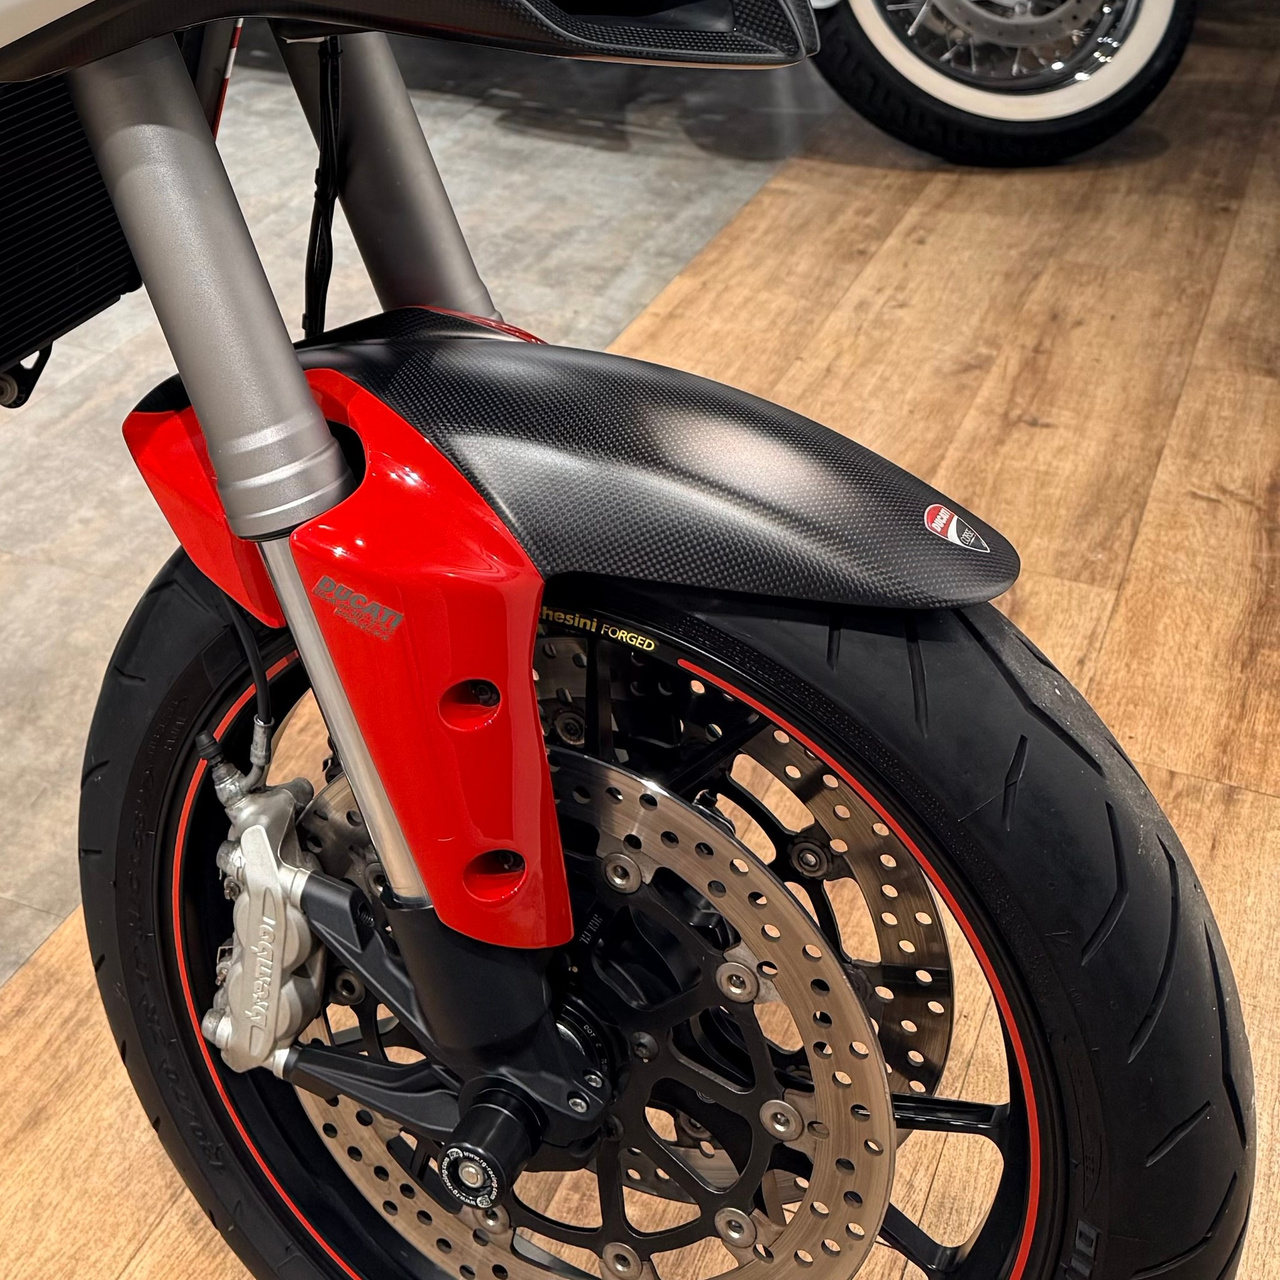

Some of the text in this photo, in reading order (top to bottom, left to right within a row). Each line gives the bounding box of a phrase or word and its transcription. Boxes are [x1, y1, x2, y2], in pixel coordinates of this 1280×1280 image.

[931, 507, 951, 533] DUCATI
[315, 575, 404, 628] DUCATI
[601, 623, 656, 652] FORGED
[244, 916, 277, 1028] brembo
